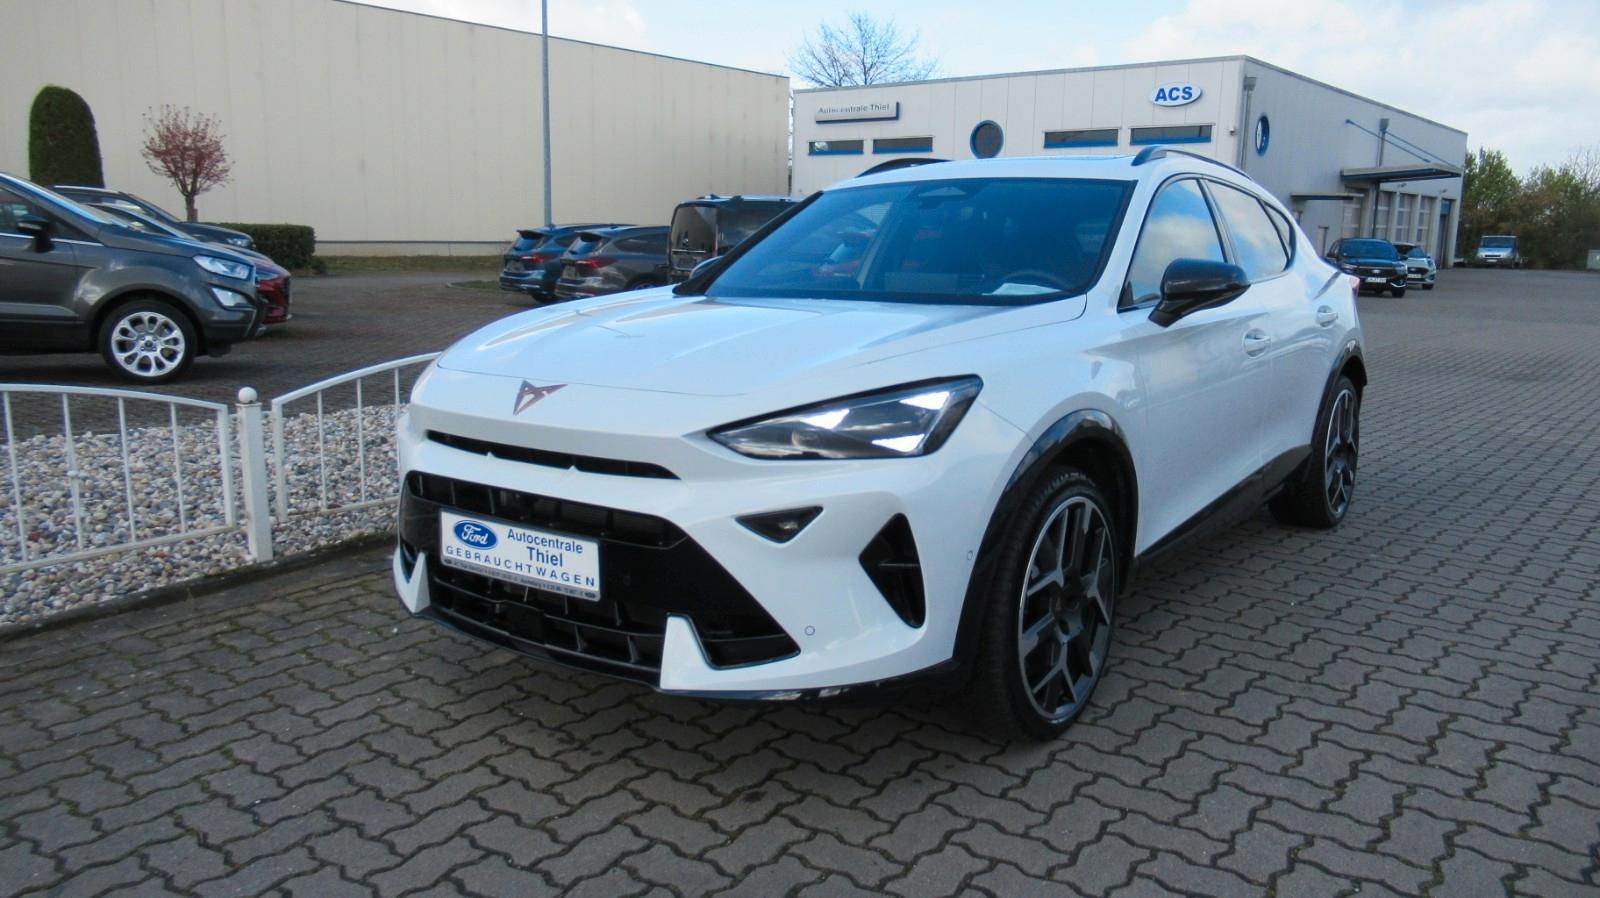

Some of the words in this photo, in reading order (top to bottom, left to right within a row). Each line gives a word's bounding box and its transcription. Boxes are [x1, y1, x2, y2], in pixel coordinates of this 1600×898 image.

[1154, 86, 1193, 102] ACS
[870, 103, 890, 111] Thiel
[461, 523, 489, 545] Ford
[507, 528, 584, 554] Autocentrale
[446, 545, 595, 587] GEBRAUCHTWAGEN
[526, 546, 564, 567] Thiel
